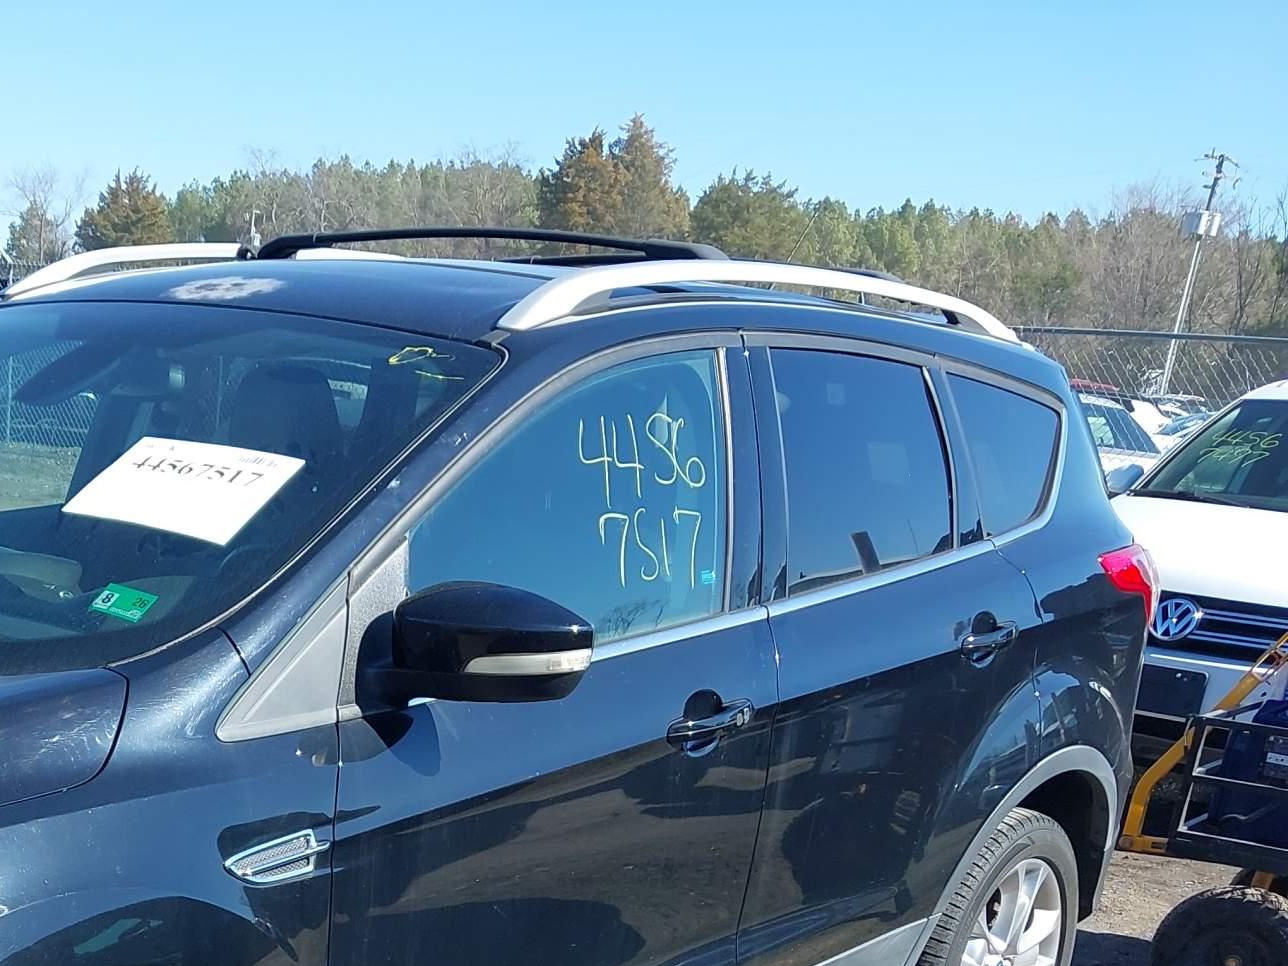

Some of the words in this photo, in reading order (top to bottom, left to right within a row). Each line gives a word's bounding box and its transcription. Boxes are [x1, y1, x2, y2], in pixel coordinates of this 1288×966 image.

[1212, 428, 1283, 448] 4456
[131, 456, 265, 488] 44567517
[578, 413, 706, 509] 4456
[599, 506, 701, 589] 7517
[101, 593, 115, 604] 8
